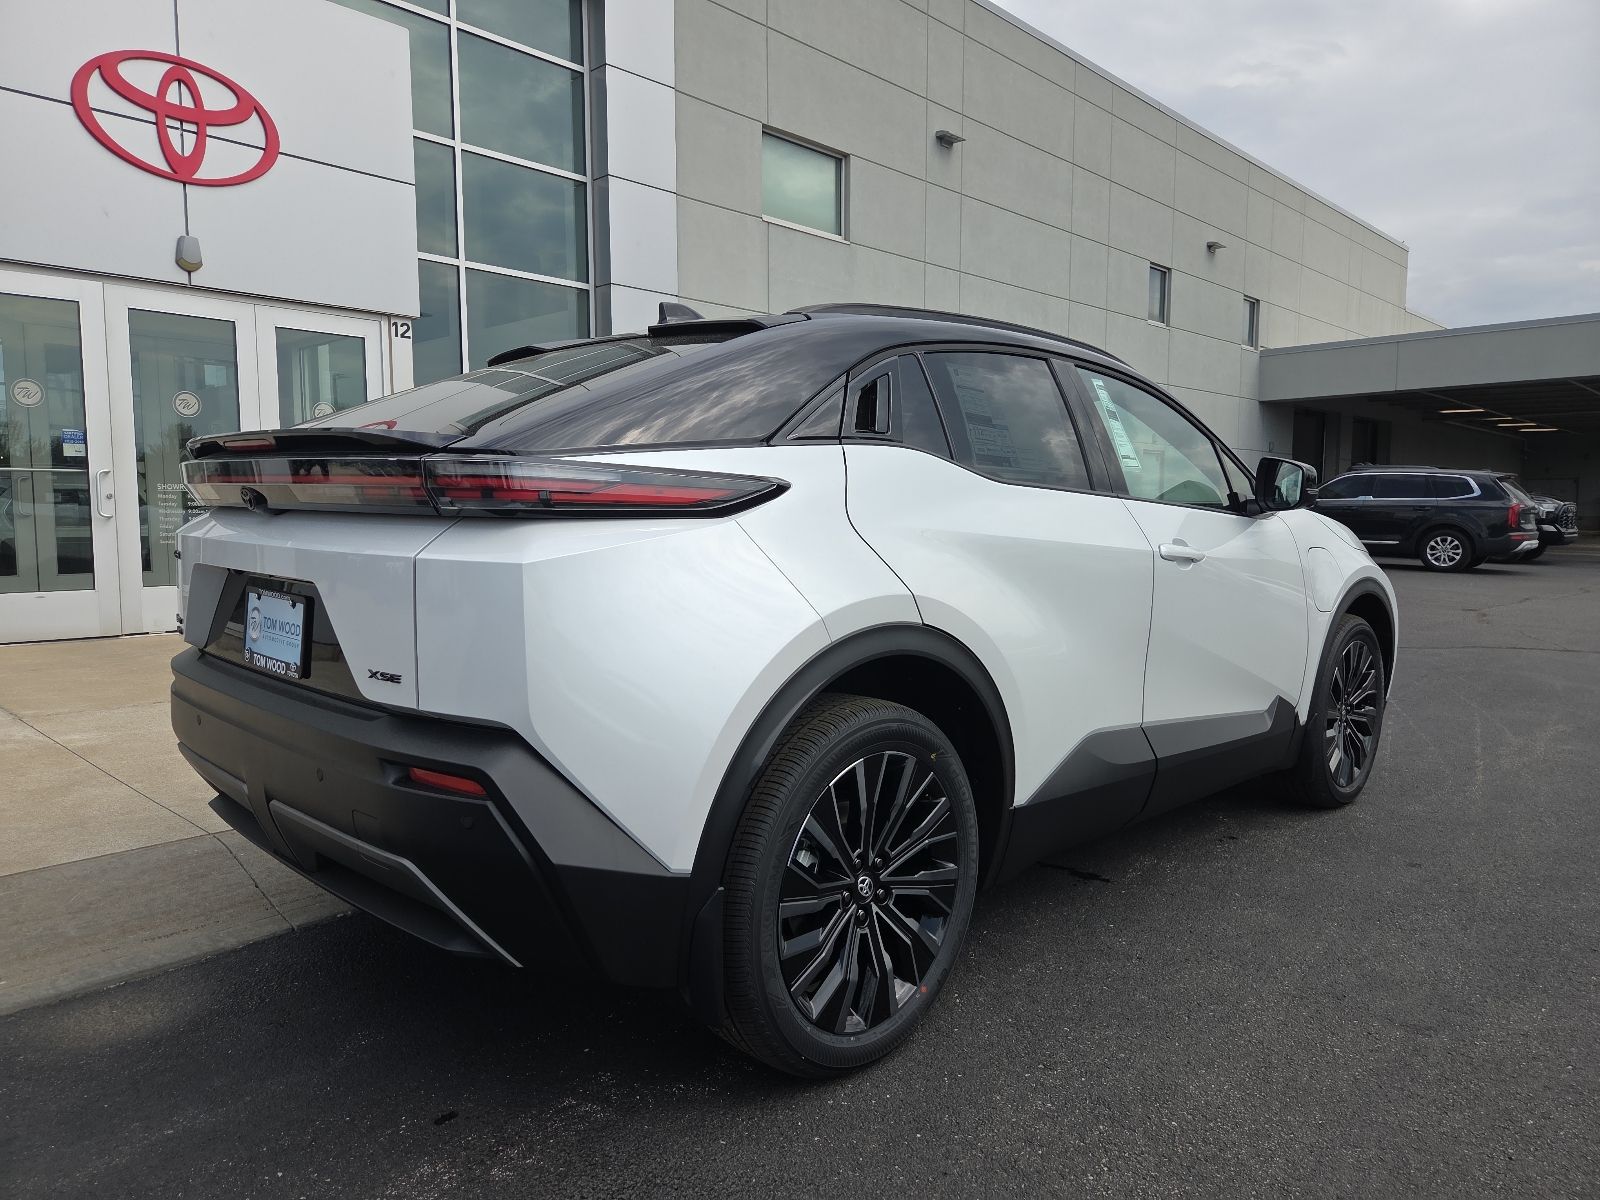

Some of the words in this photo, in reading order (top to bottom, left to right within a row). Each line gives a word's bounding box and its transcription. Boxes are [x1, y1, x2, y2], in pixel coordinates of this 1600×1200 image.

[392, 321, 411, 339] 12
[263, 616, 278, 632] TOM
[278, 620, 301, 637] WOOD
[253, 653, 266, 668] TOM
[266, 657, 286, 675] WOOD
[367, 668, 402, 684] XSE
